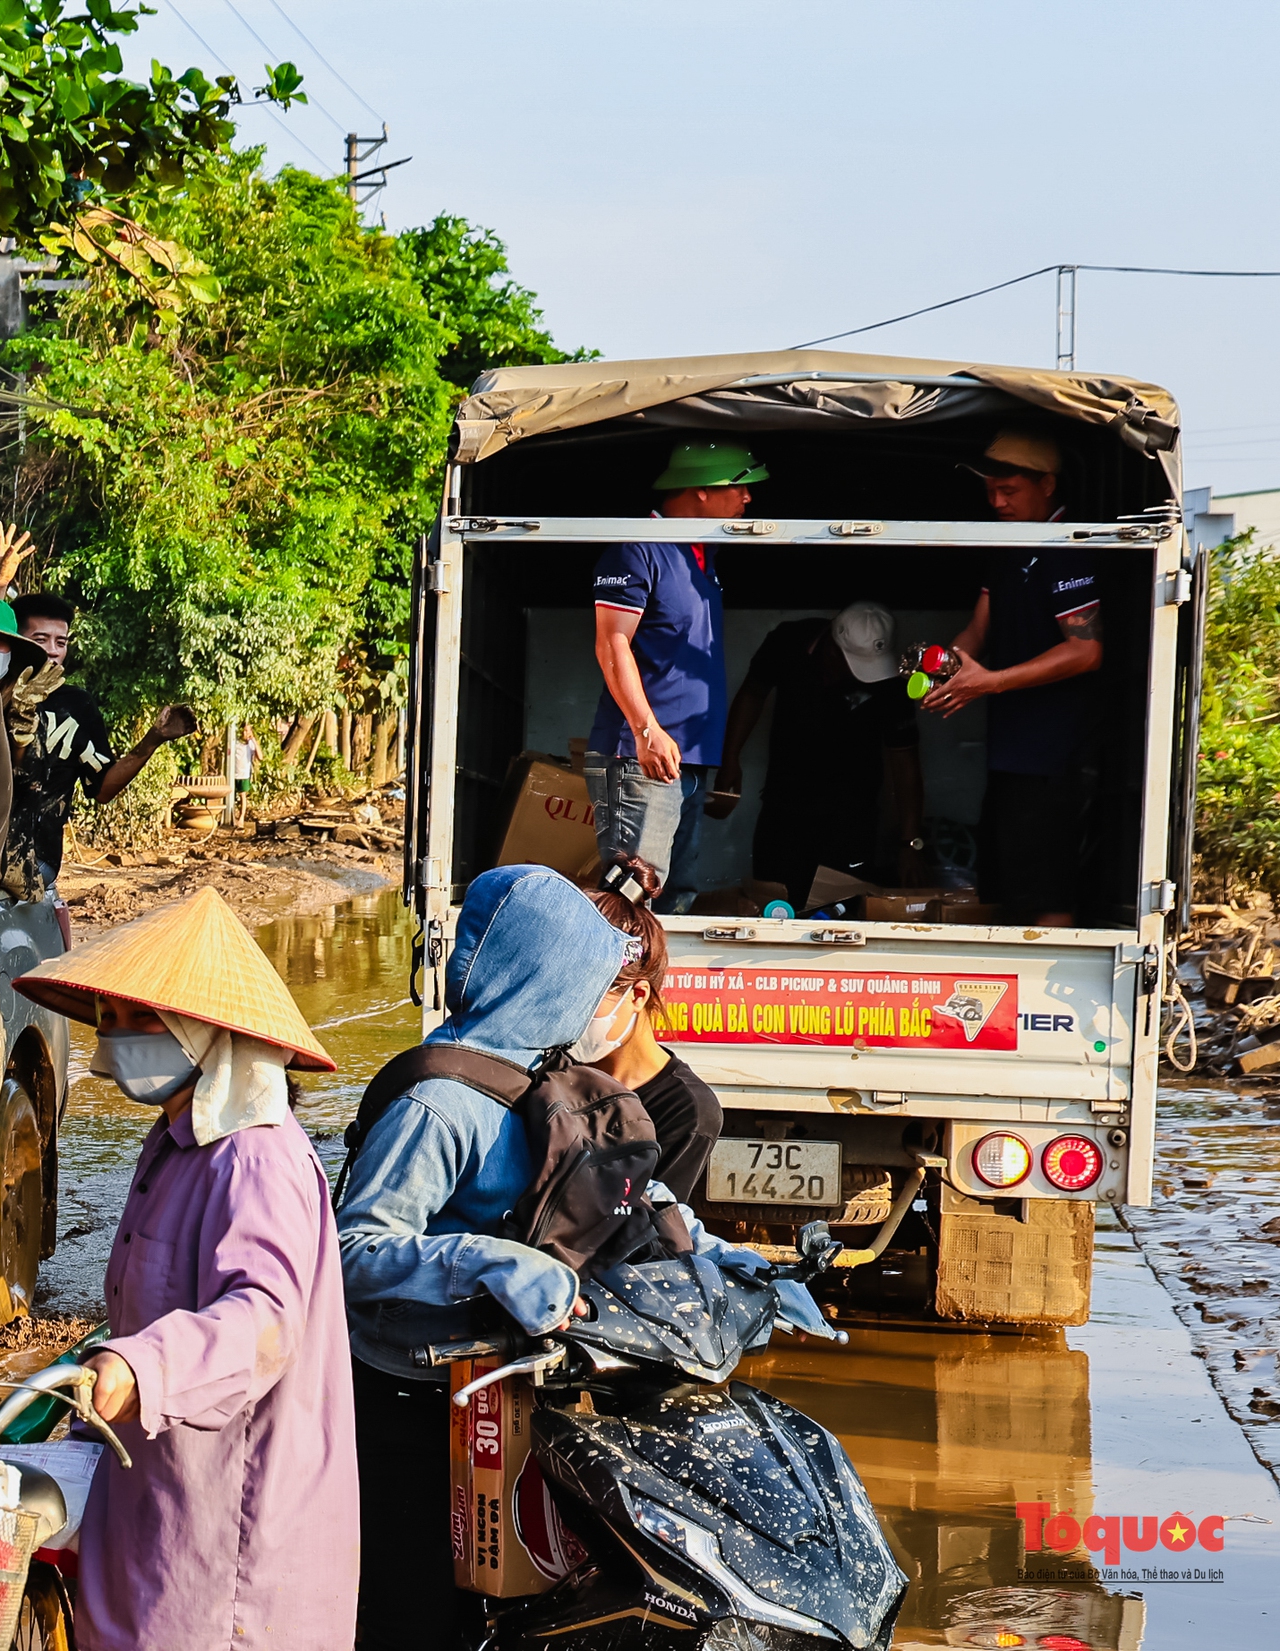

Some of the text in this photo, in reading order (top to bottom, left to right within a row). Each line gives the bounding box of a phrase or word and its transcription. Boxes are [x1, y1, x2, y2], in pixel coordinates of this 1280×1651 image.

[544, 795, 578, 820] QL
[694, 975, 707, 989] BI
[755, 975, 778, 991] CLB
[780, 977, 824, 993] PICKUP
[827, 978, 838, 993] &
[840, 978, 865, 994] SUV
[866, 975, 908, 995] QUẢNG
[911, 976, 941, 995] BÌNH
[692, 996, 724, 1036] QUÀ
[727, 997, 749, 1034] BÀ
[752, 1003, 786, 1035] CON
[789, 999, 831, 1035] VÙNG
[834, 1000, 855, 1036] LŨ
[858, 1001, 895, 1037] PHÍA
[899, 997, 932, 1038] BẮC
[747, 1144, 801, 1170] 73C
[727, 1172, 825, 1201] 144.20
[476, 1420, 499, 1455] 30
[701, 1418, 747, 1434] HONDA
[477, 1493, 488, 1567] VỊ NGON
[643, 1592, 699, 1622] HONDA
